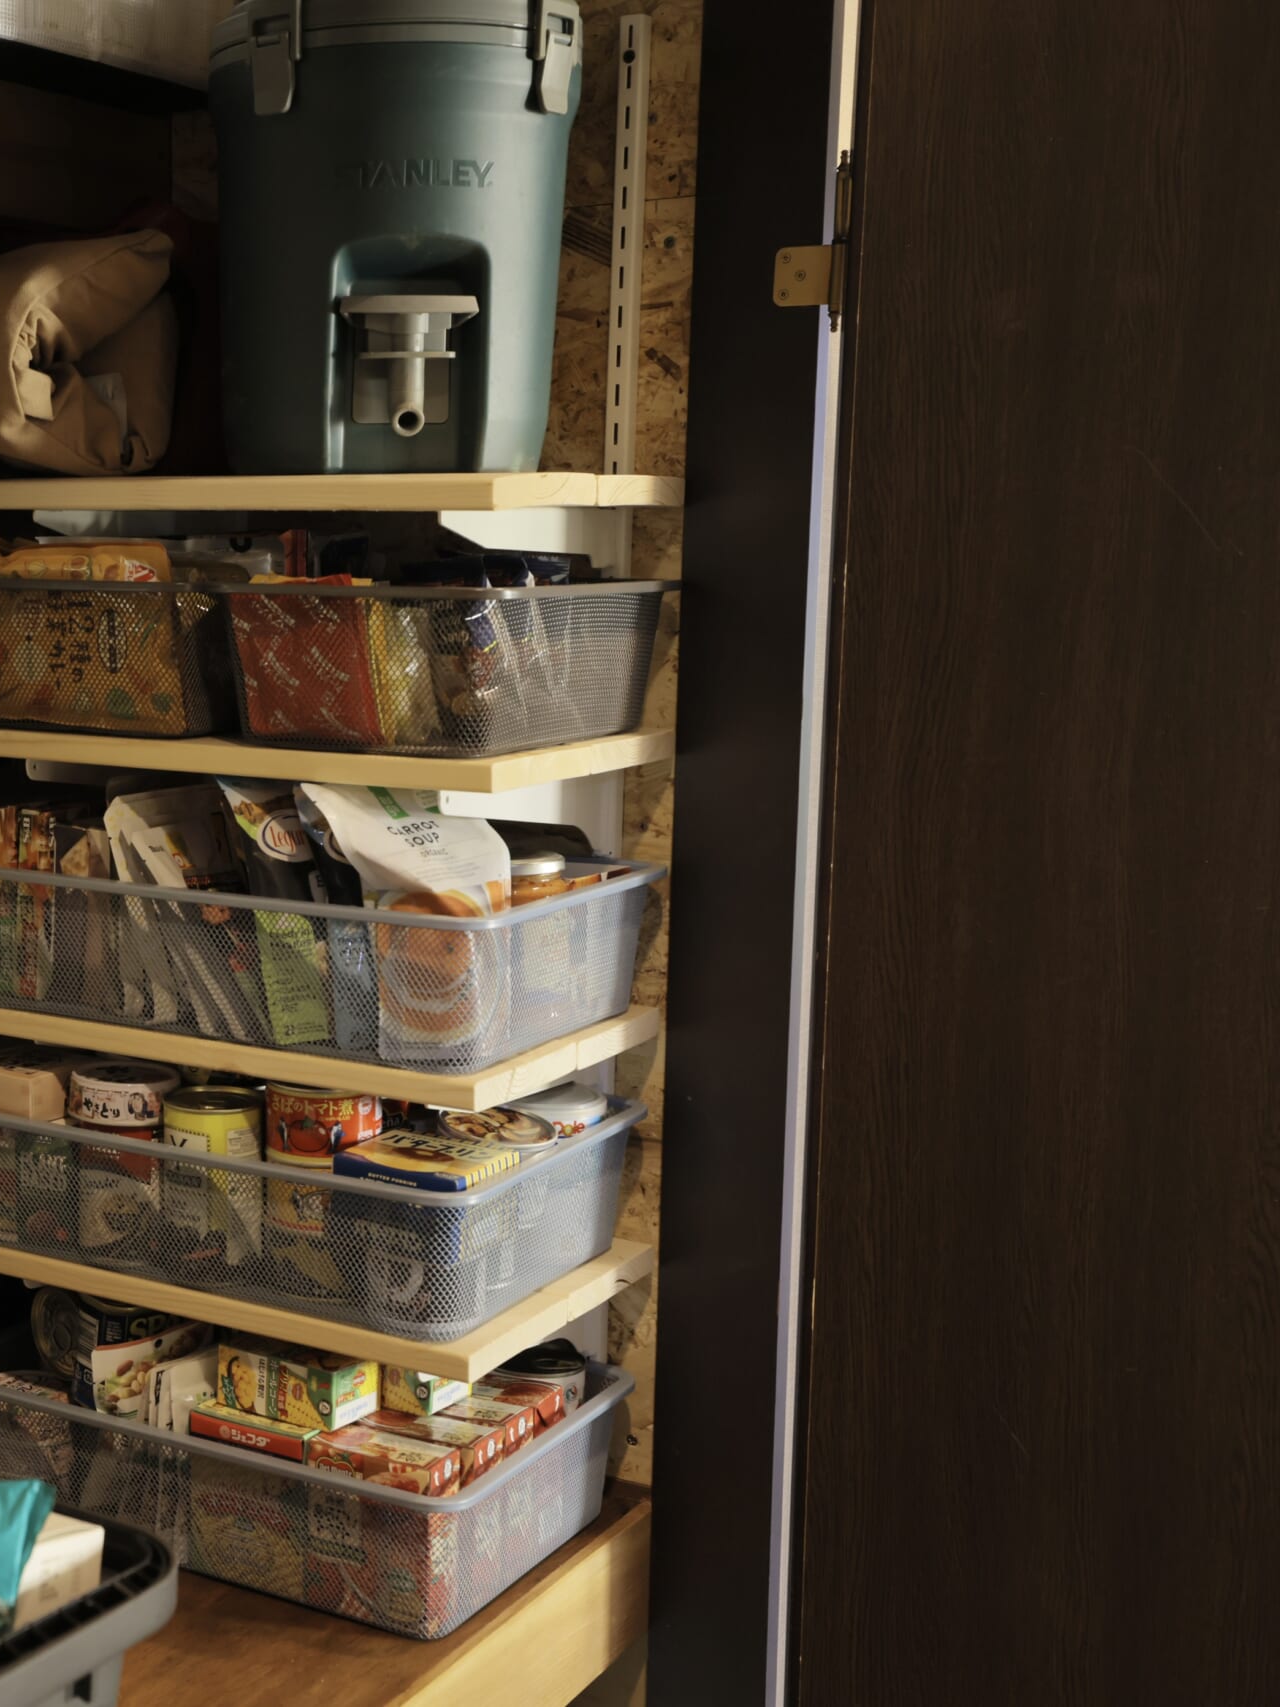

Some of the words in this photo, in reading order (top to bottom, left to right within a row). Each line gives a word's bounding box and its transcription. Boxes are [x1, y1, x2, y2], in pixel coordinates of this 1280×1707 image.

[387, 821, 439, 836] CARROT
[405, 832, 440, 847] SOUP
[83, 1096, 121, 1119] やきとり
[271, 1095, 355, 1116] さばのトマト煮
[231, 1428, 270, 1447] ジェフダ
